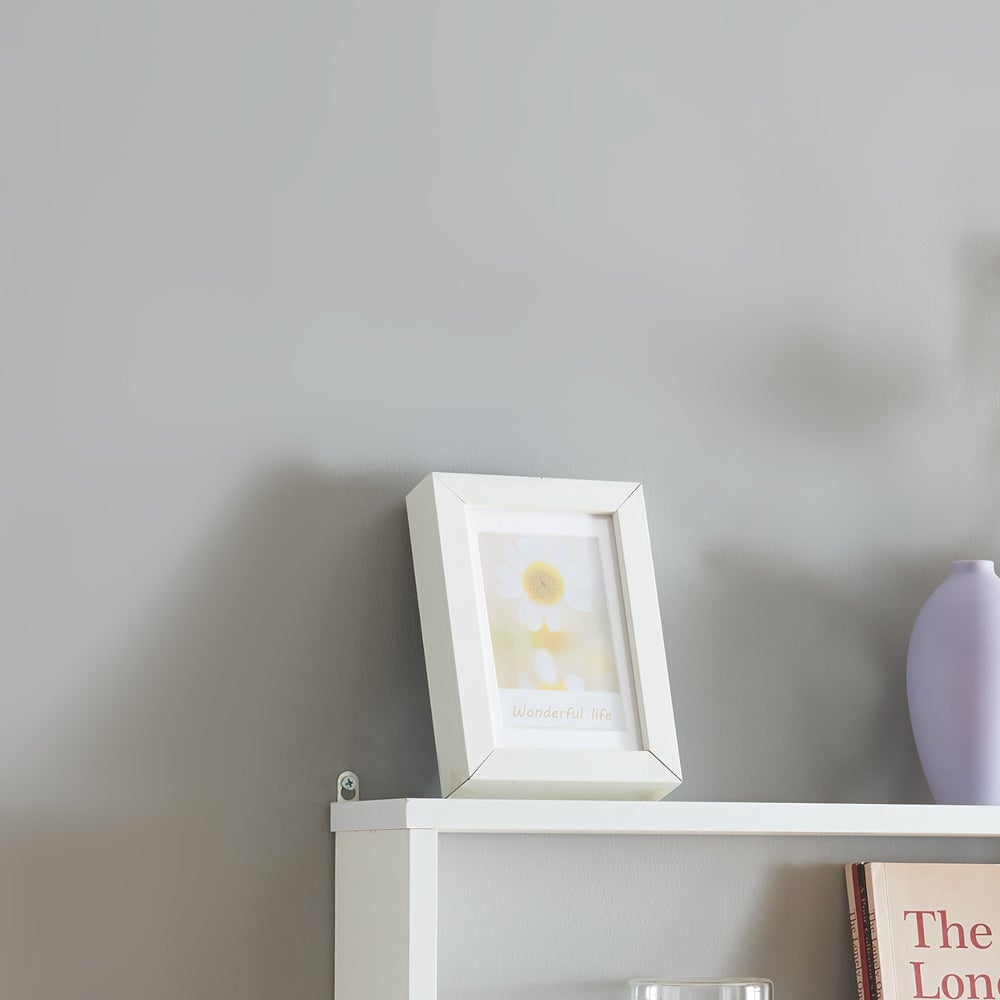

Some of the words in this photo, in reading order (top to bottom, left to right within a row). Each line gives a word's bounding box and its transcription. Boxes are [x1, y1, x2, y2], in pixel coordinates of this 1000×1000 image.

[512, 704, 584, 720] Wonderful
[591, 707, 612, 720] life
[903, 909, 993, 949] The
[852, 938, 862, 977] Lonely
[871, 938, 881, 977] Lonely
